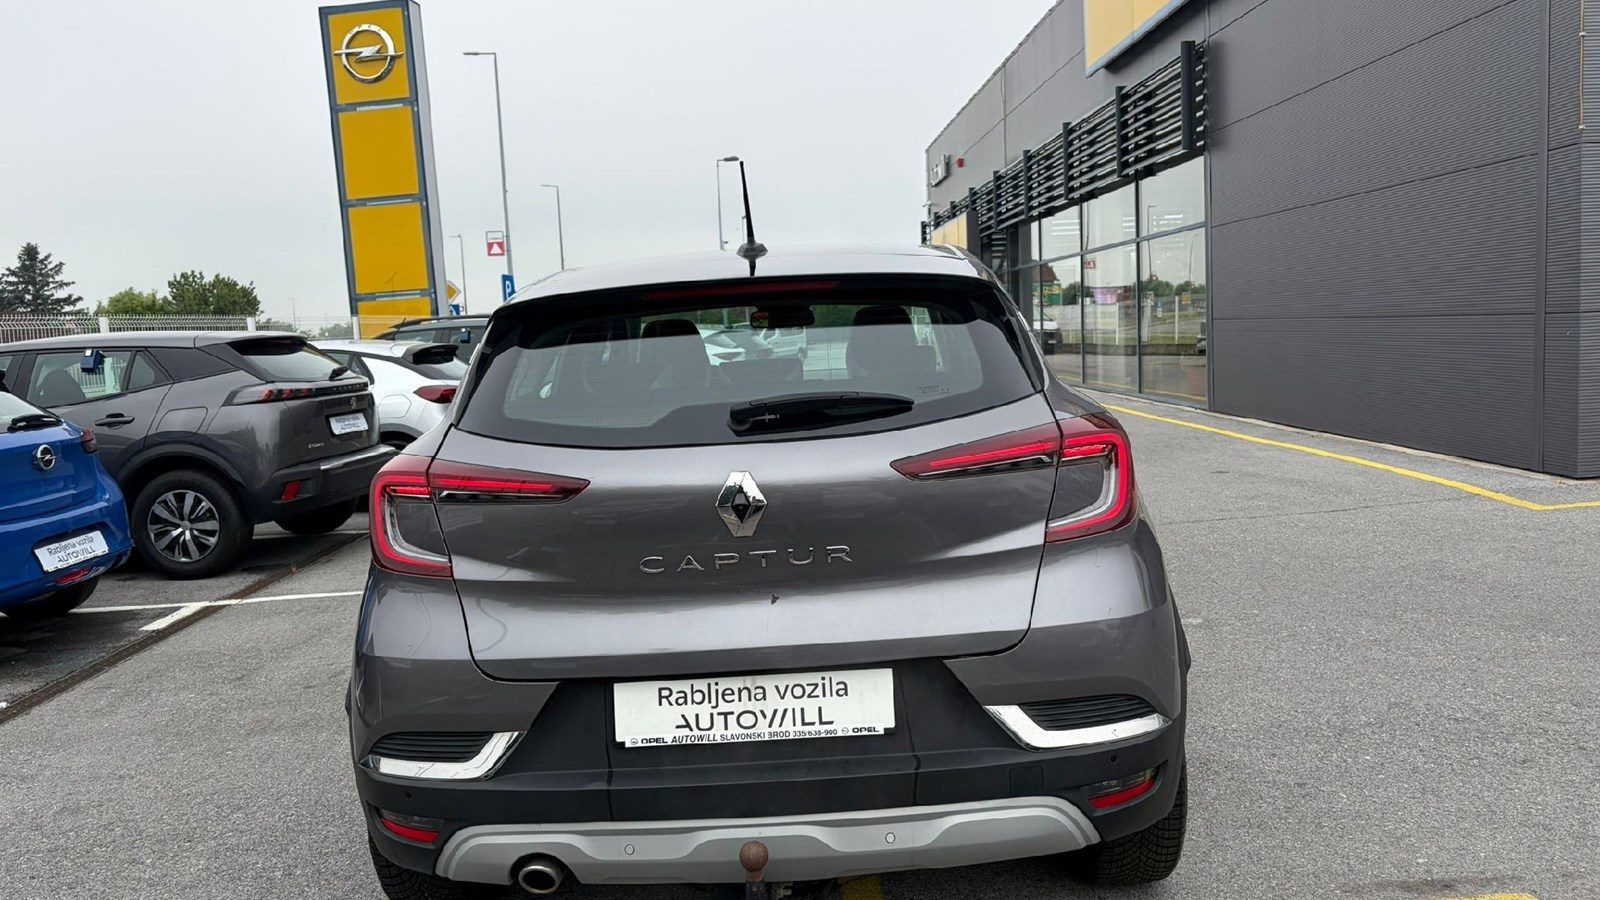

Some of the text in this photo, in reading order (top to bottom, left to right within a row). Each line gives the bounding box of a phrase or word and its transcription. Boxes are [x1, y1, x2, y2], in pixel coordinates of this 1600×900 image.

[505, 280, 512, 299] P
[639, 545, 853, 574] CAPTUR
[658, 676, 849, 709] Rabljena vozila
[675, 706, 835, 732] AUTOWILL
[671, 733, 718, 744] AUTOWILL
[720, 732, 766, 741] SLAVONSKI
[768, 730, 791, 739] BROD
[852, 726, 879, 734] OPEL
